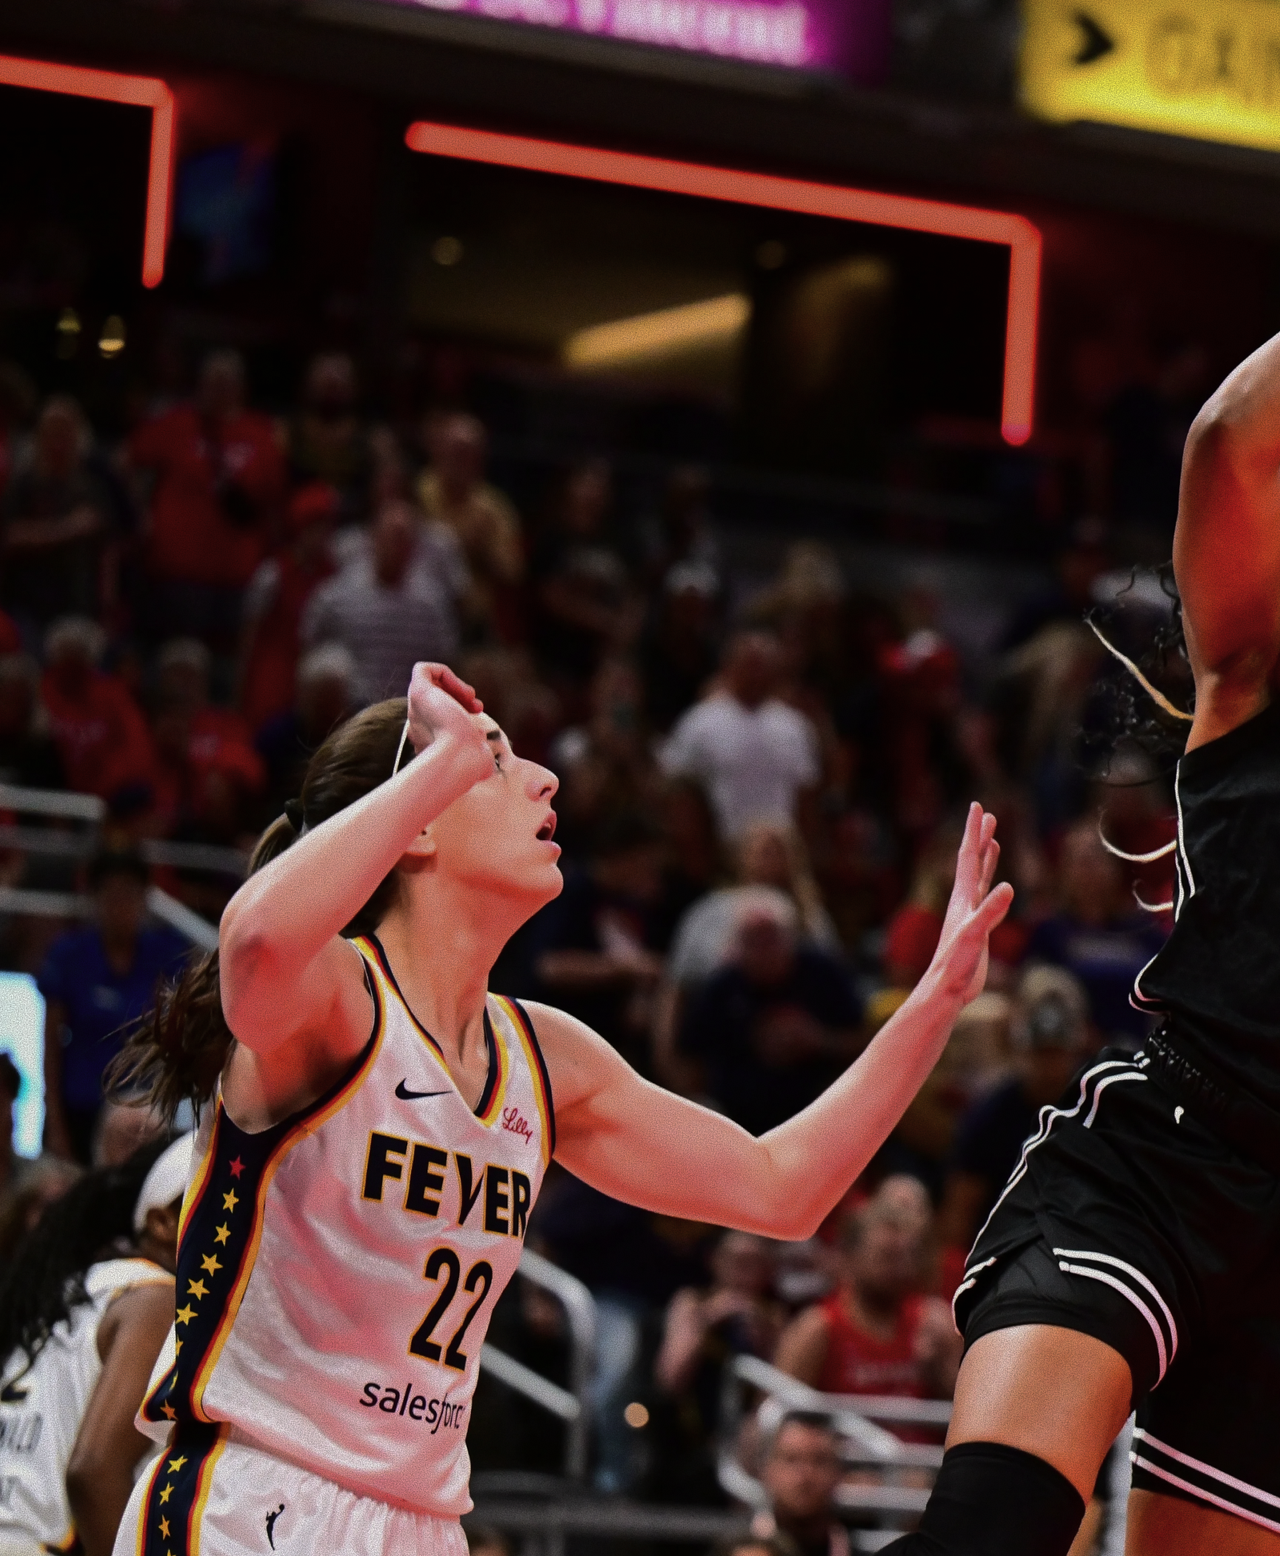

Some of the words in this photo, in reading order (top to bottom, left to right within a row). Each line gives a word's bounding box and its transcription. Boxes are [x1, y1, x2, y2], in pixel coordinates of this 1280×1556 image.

[502, 1107, 533, 1145] Lilly
[360, 1129, 532, 1240] FEVER
[406, 1245, 494, 1373] 22
[359, 1382, 466, 1435] salesforc
